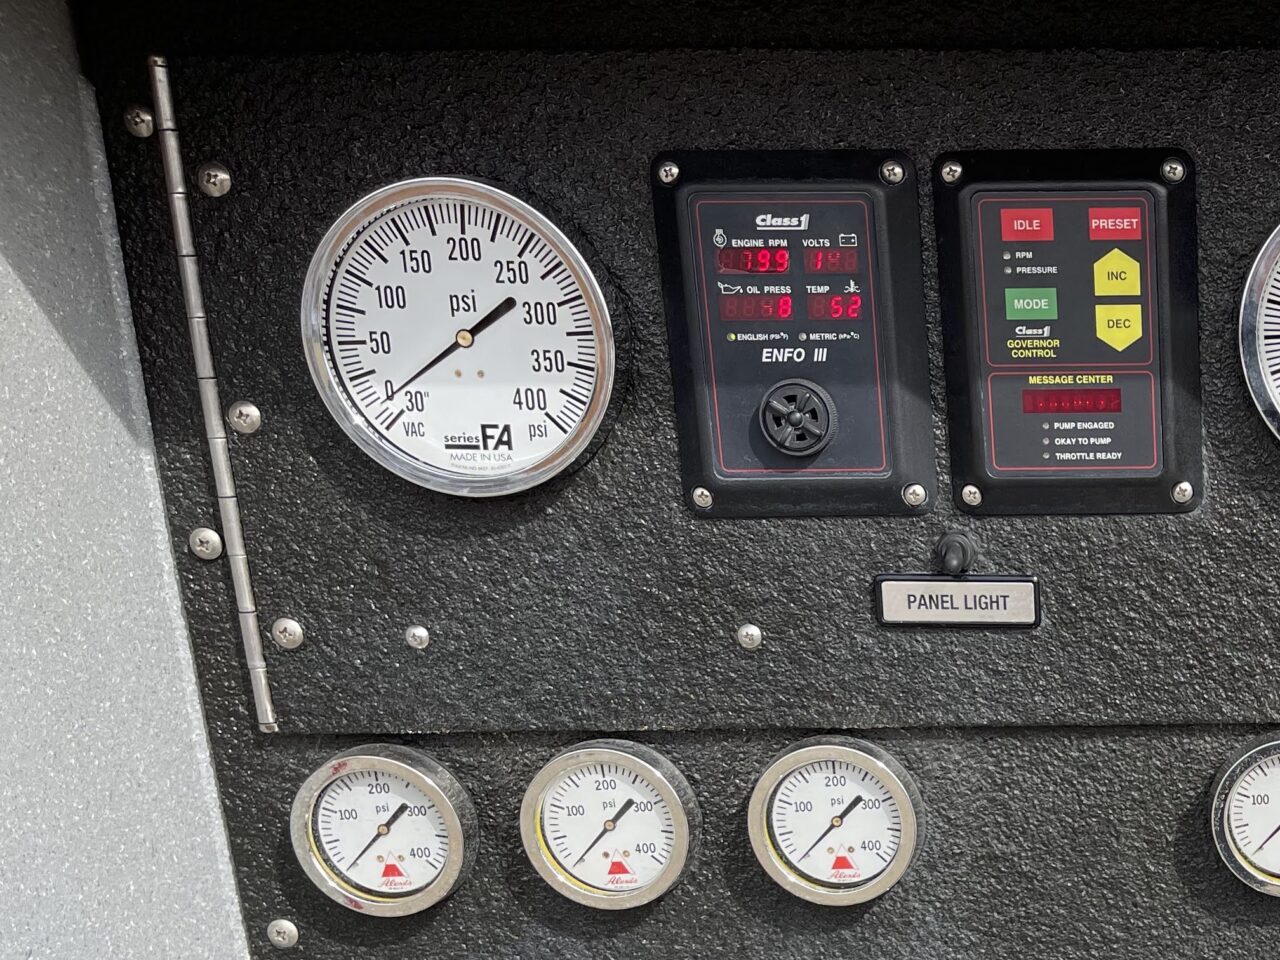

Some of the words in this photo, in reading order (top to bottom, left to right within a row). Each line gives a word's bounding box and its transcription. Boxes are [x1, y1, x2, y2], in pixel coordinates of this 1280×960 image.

[756, 214, 809, 230] Class1
[1014, 220, 1040, 230] IDLE
[1092, 219, 1138, 229] PRESET
[732, 239, 764, 247] ENGINE
[769, 238, 788, 247] RPM
[802, 239, 829, 247] VOLTS
[447, 238, 481, 261] 200
[1016, 251, 1032, 259] RPM
[400, 250, 432, 273] 150
[494, 261, 529, 284] 250
[1016, 266, 1057, 275] PRESSURE
[1107, 271, 1127, 281] INC
[747, 285, 760, 294] OIL
[764, 285, 791, 294] PRESS
[806, 285, 829, 294] TEMP
[376, 286, 406, 309] 100
[450, 289, 476, 316] psi
[1014, 299, 1048, 310] MODE
[524, 302, 557, 325] 300
[1107, 319, 1131, 329] DEC
[1016, 326, 1050, 337] Class1
[369, 331, 391, 354] 50
[1007, 339, 1060, 349] GOVERNOR
[762, 348, 805, 362] ENFO
[814, 348, 827, 362] III
[1012, 349, 1056, 358] CONTROL
[531, 350, 564, 372] 350
[1029, 375, 1074, 385] MESSAGE
[1076, 374, 1113, 384] CENTER
[513, 388, 546, 410] 400
[403, 422, 425, 437] VAC
[529, 420, 548, 440] psi
[1054, 421, 1075, 430] PUMP
[1076, 421, 1115, 430] ENGAGED
[444, 433, 480, 444] series
[481, 424, 513, 450] FA
[1054, 437, 1076, 446] OKAY
[1078, 437, 1088, 446] TO
[1090, 437, 1111, 445] PUMP
[1055, 452, 1094, 460] THROTTLE
[1096, 452, 1122, 460] READY
[907, 594, 959, 610] PANEL
[964, 595, 1010, 610] LIGHT
[595, 780, 616, 791] 200
[825, 776, 846, 787] 200
[368, 783, 390, 794] 200
[603, 799, 616, 810] psi
[831, 796, 844, 807] psi
[1252, 794, 1269, 805] 100
[376, 803, 389, 815] psi
[566, 805, 584, 816] 100
[794, 801, 812, 812] 100
[339, 809, 357, 820] 100
[635, 843, 656, 854] 400
[861, 840, 881, 851] 400
[410, 847, 430, 858] 400
